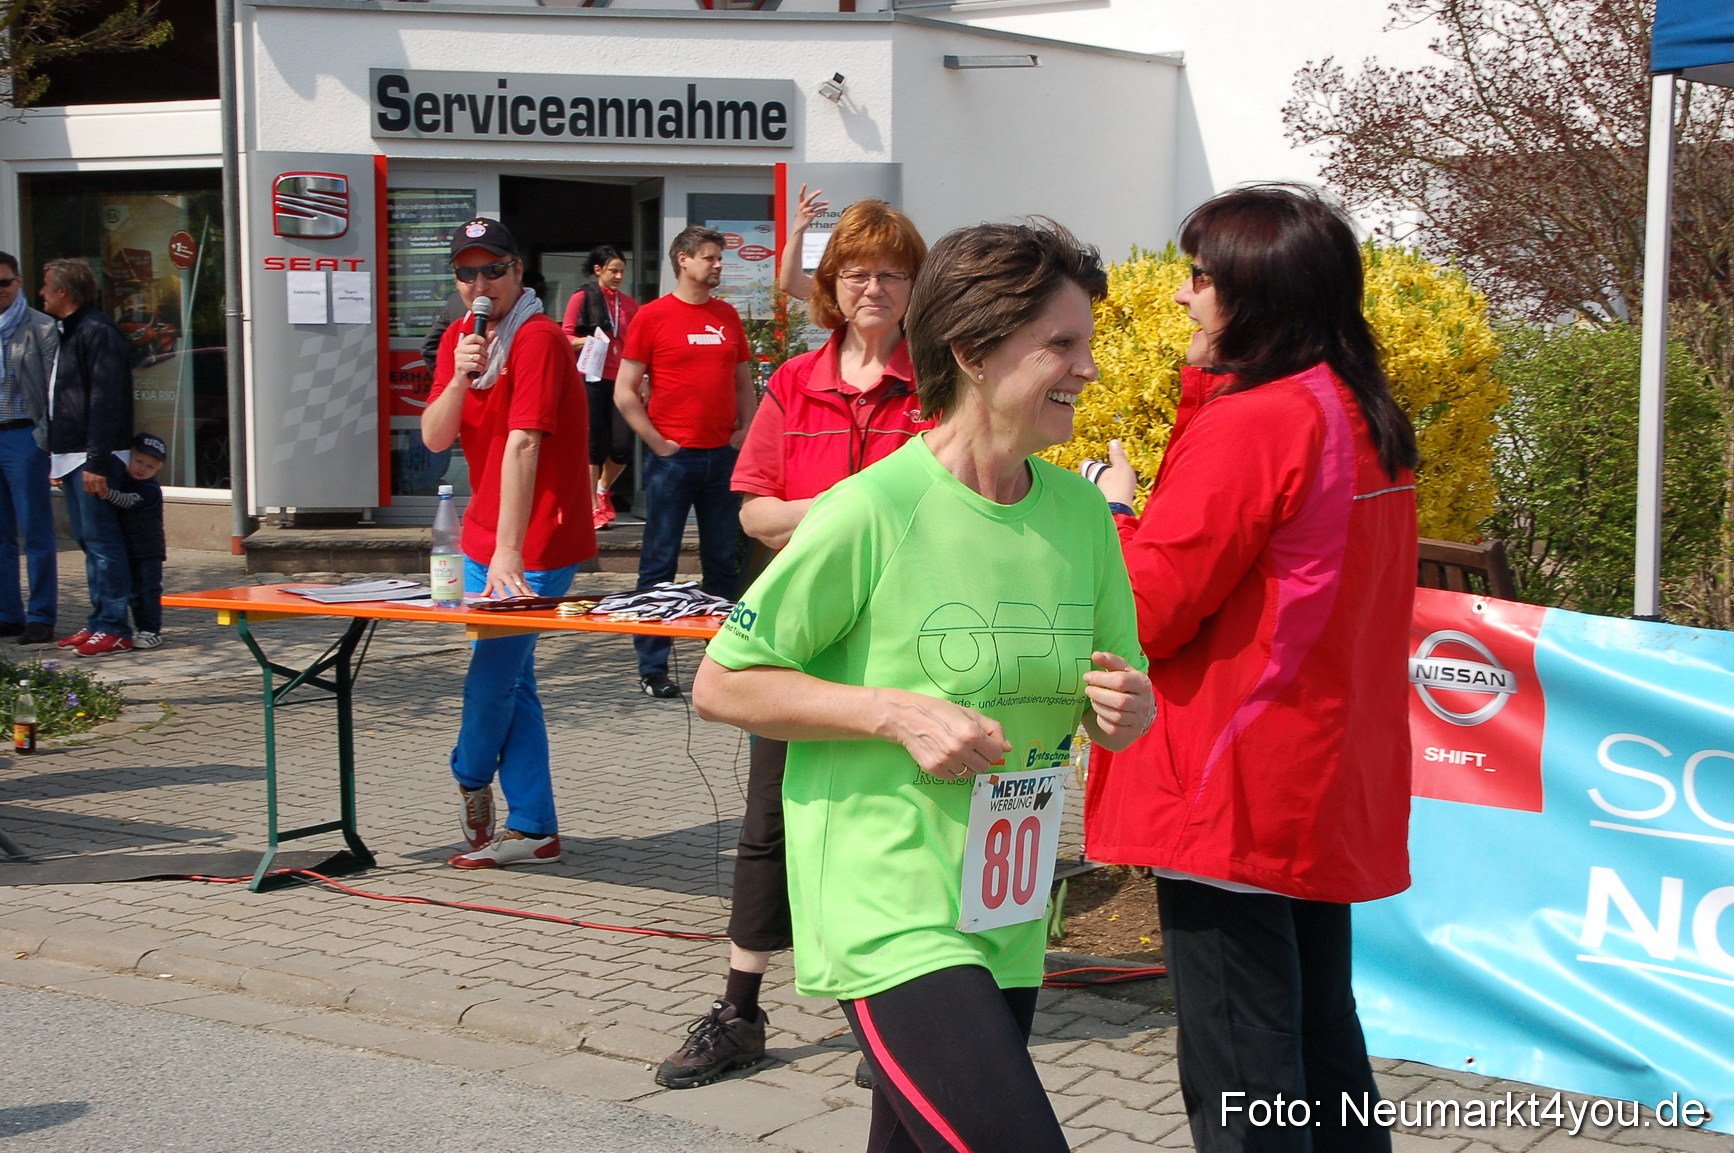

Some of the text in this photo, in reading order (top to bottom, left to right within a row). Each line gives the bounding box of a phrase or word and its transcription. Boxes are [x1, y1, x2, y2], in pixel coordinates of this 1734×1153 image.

[377, 74, 787, 141] Serviceannahme
[264, 256, 366, 272] SEAT
[1415, 664, 1506, 687] NISSAN
[978, 697, 996, 708] und
[991, 777, 1037, 799] MEYER
[990, 796, 1032, 812] WERBUNG
[981, 815, 1041, 910] 80
